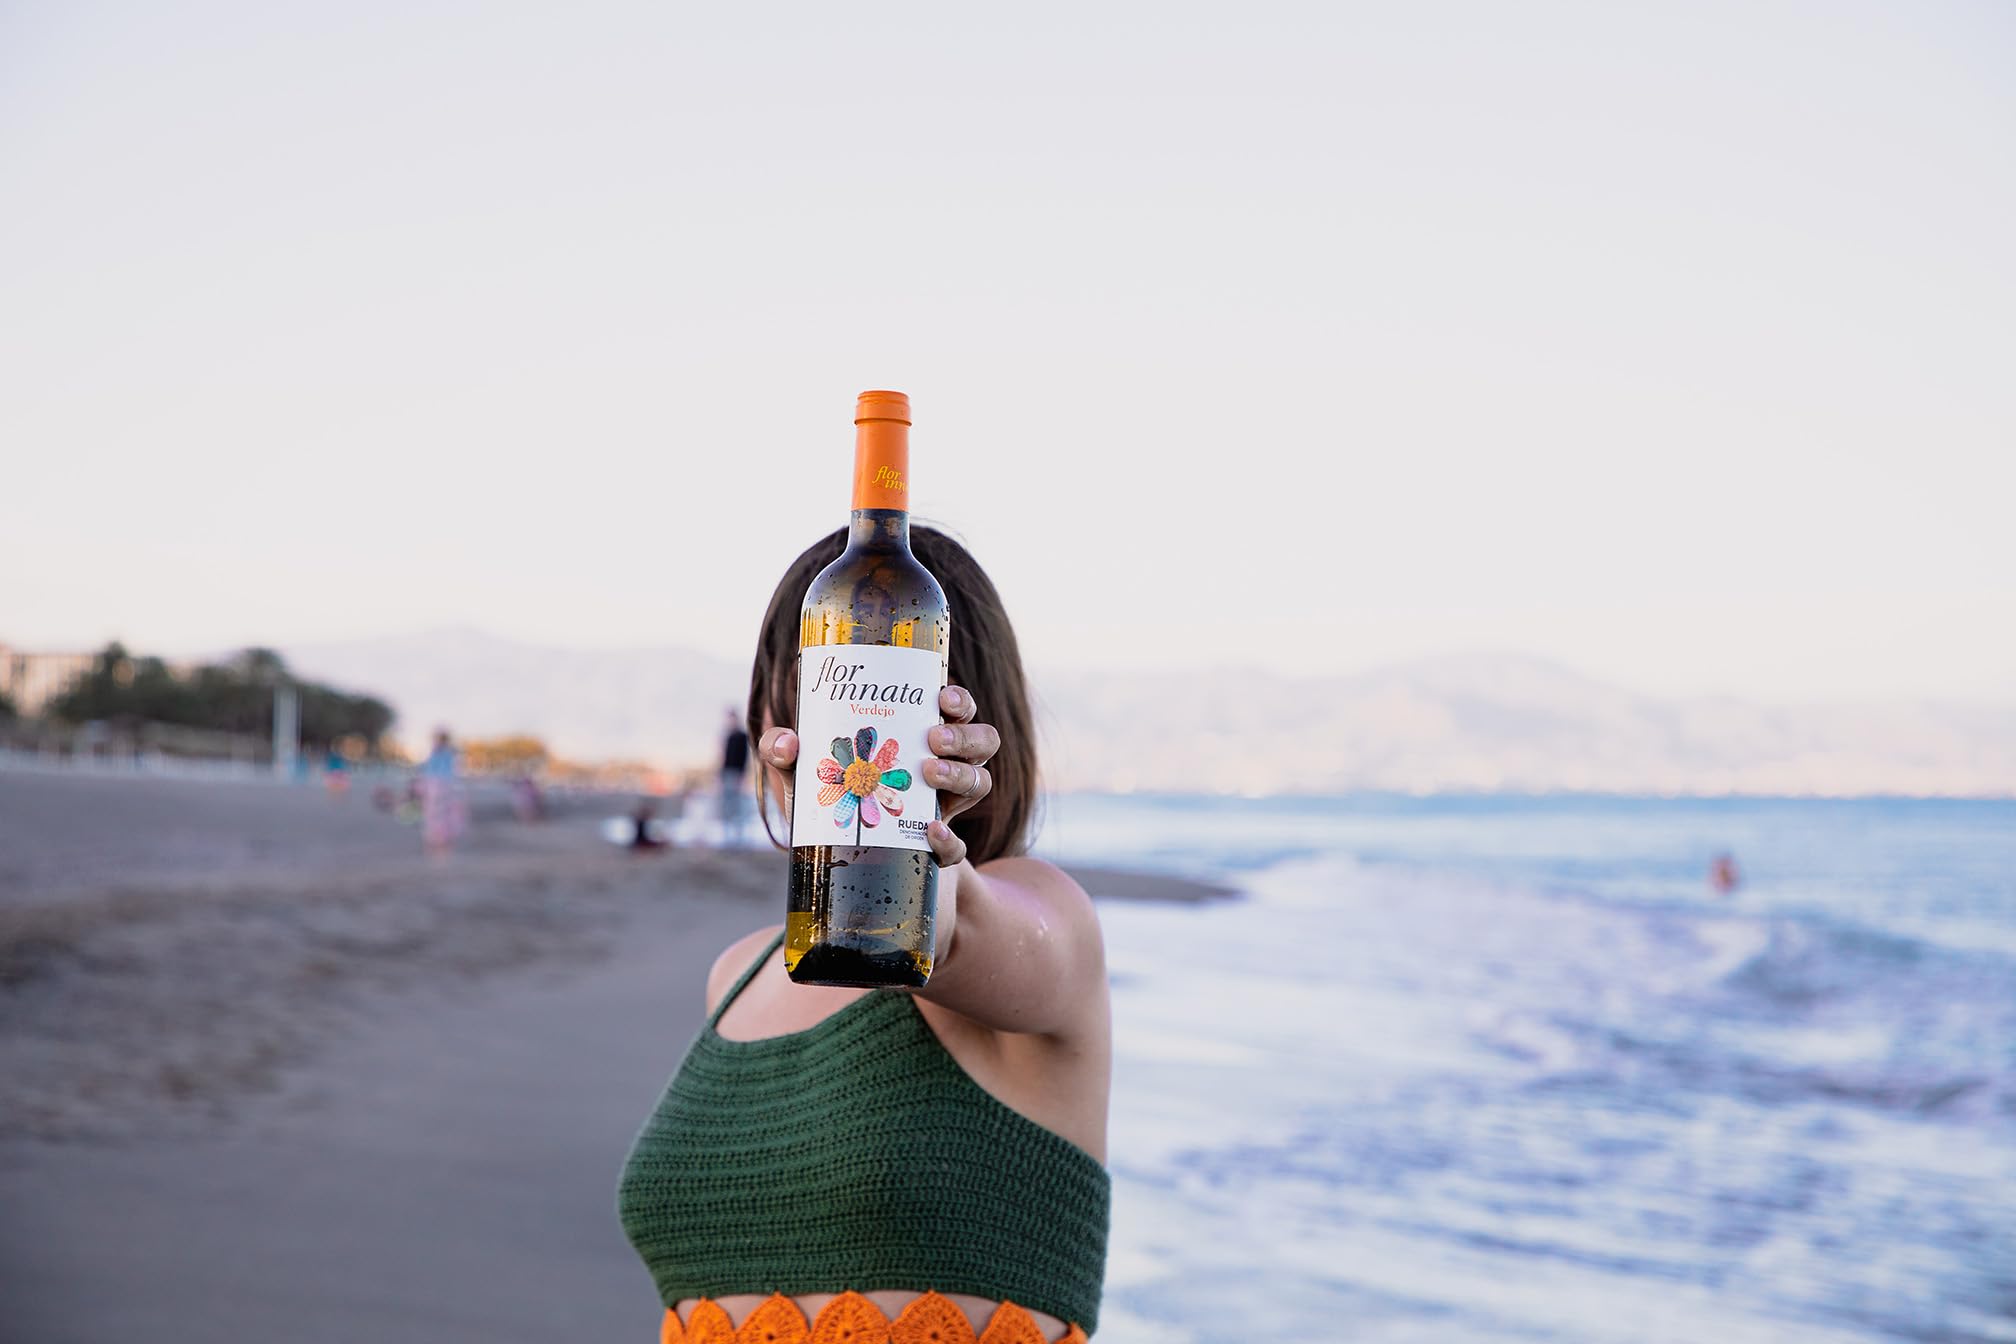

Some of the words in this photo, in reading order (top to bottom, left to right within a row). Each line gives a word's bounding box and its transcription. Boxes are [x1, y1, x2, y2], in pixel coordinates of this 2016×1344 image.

[872, 465, 902, 484] flor
[885, 480, 905, 492] inn
[812, 656, 864, 692] flor
[830, 682, 924, 706] innata
[850, 704, 895, 718] Verdejo
[898, 819, 928, 830] RUEDA
